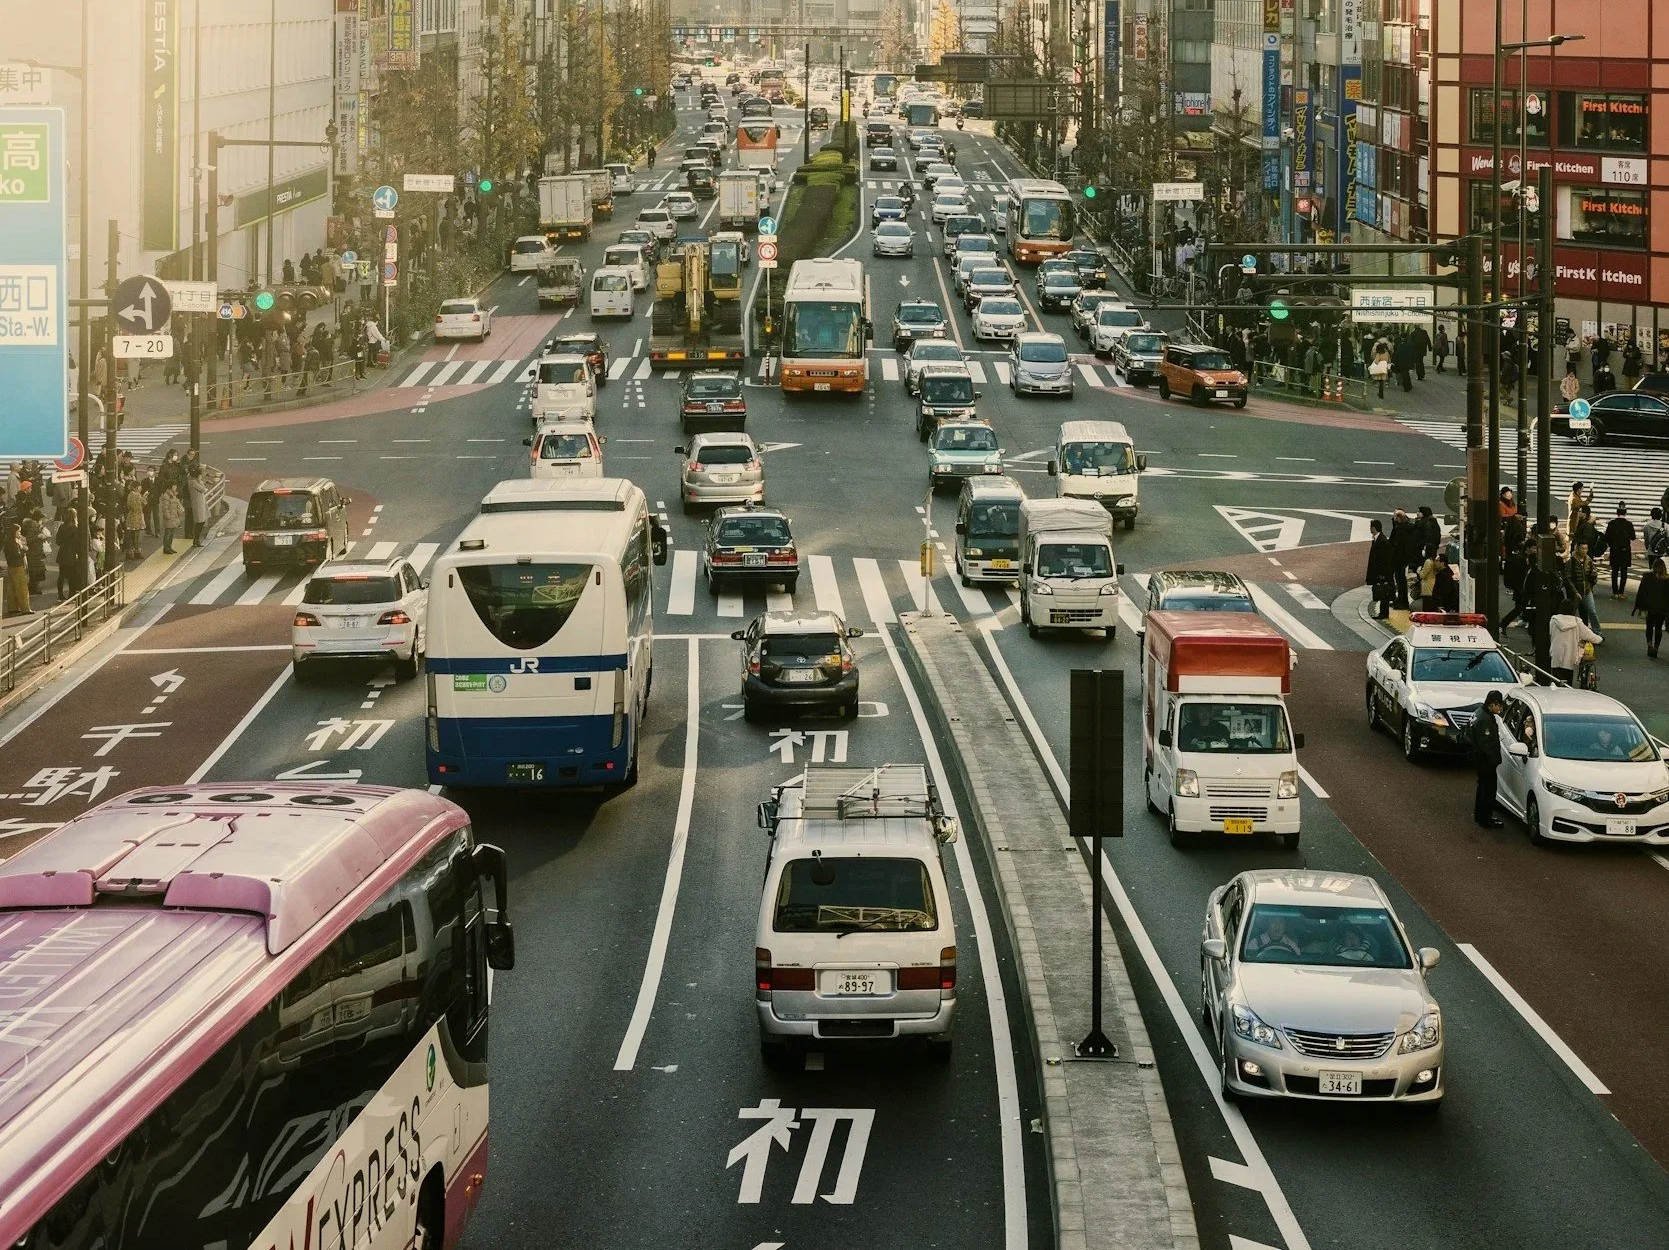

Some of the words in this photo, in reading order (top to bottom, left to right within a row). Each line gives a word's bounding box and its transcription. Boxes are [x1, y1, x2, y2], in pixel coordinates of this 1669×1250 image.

[2, 131, 41, 171] 高
[1555, 162, 1594, 175] Kitchen
[1556, 266, 1585, 280] First
[1586, 267, 1642, 285] Kitchen
[1360, 296, 1426, 307] 西新宿一丁目
[1431, 634, 1478, 644] 警視庁
[509, 657, 540, 674] JR
[530, 768, 543, 781] 16
[845, 981, 874, 992] 89-97
[1329, 1081, 1358, 1093] 34-61
[725, 1099, 876, 1204] 初
[318, 1096, 421, 1250] EXPRESS
